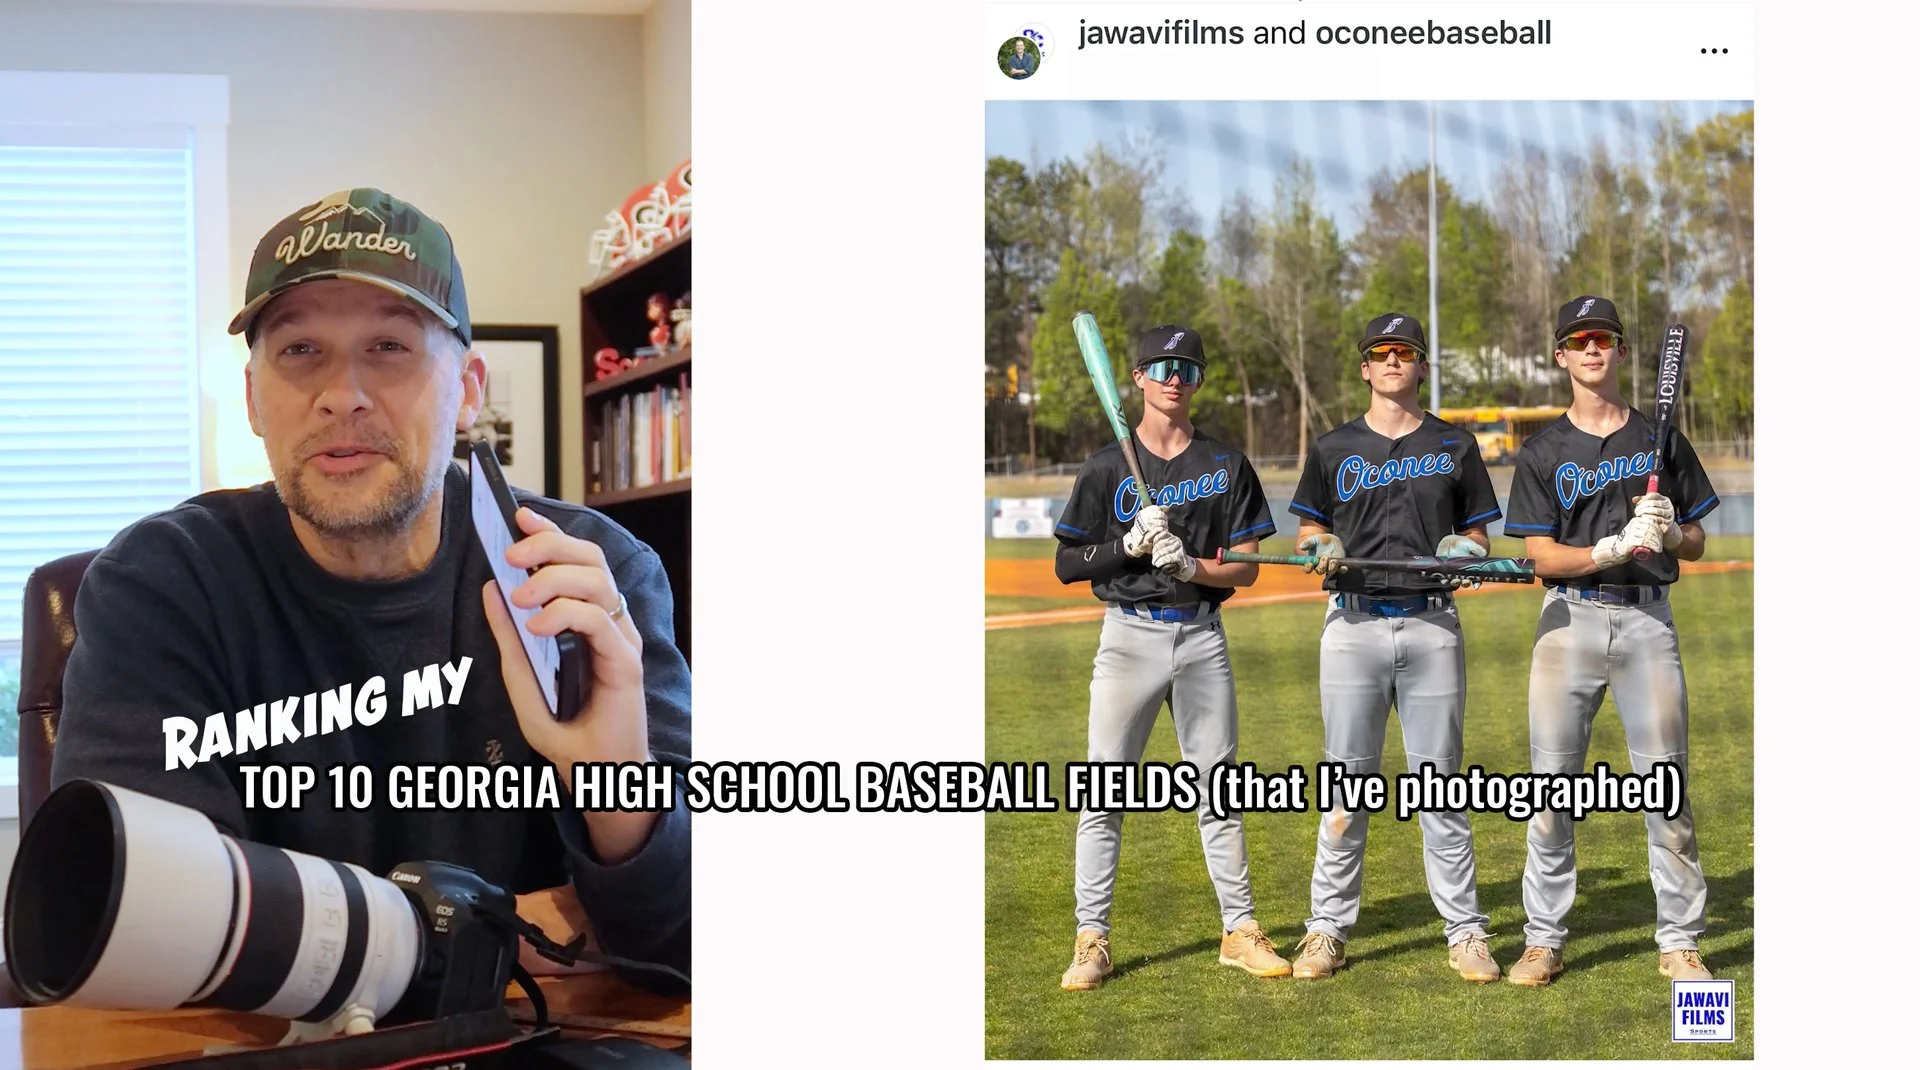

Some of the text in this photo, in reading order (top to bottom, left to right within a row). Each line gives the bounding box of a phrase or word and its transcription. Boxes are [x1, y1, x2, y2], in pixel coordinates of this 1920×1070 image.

[275, 219, 417, 264] Wander
[1659, 327, 1684, 405] LOUISVILLE
[1336, 452, 1455, 502] Oconee
[391, 871, 421, 884] Canon
[436, 904, 455, 917] EOS
